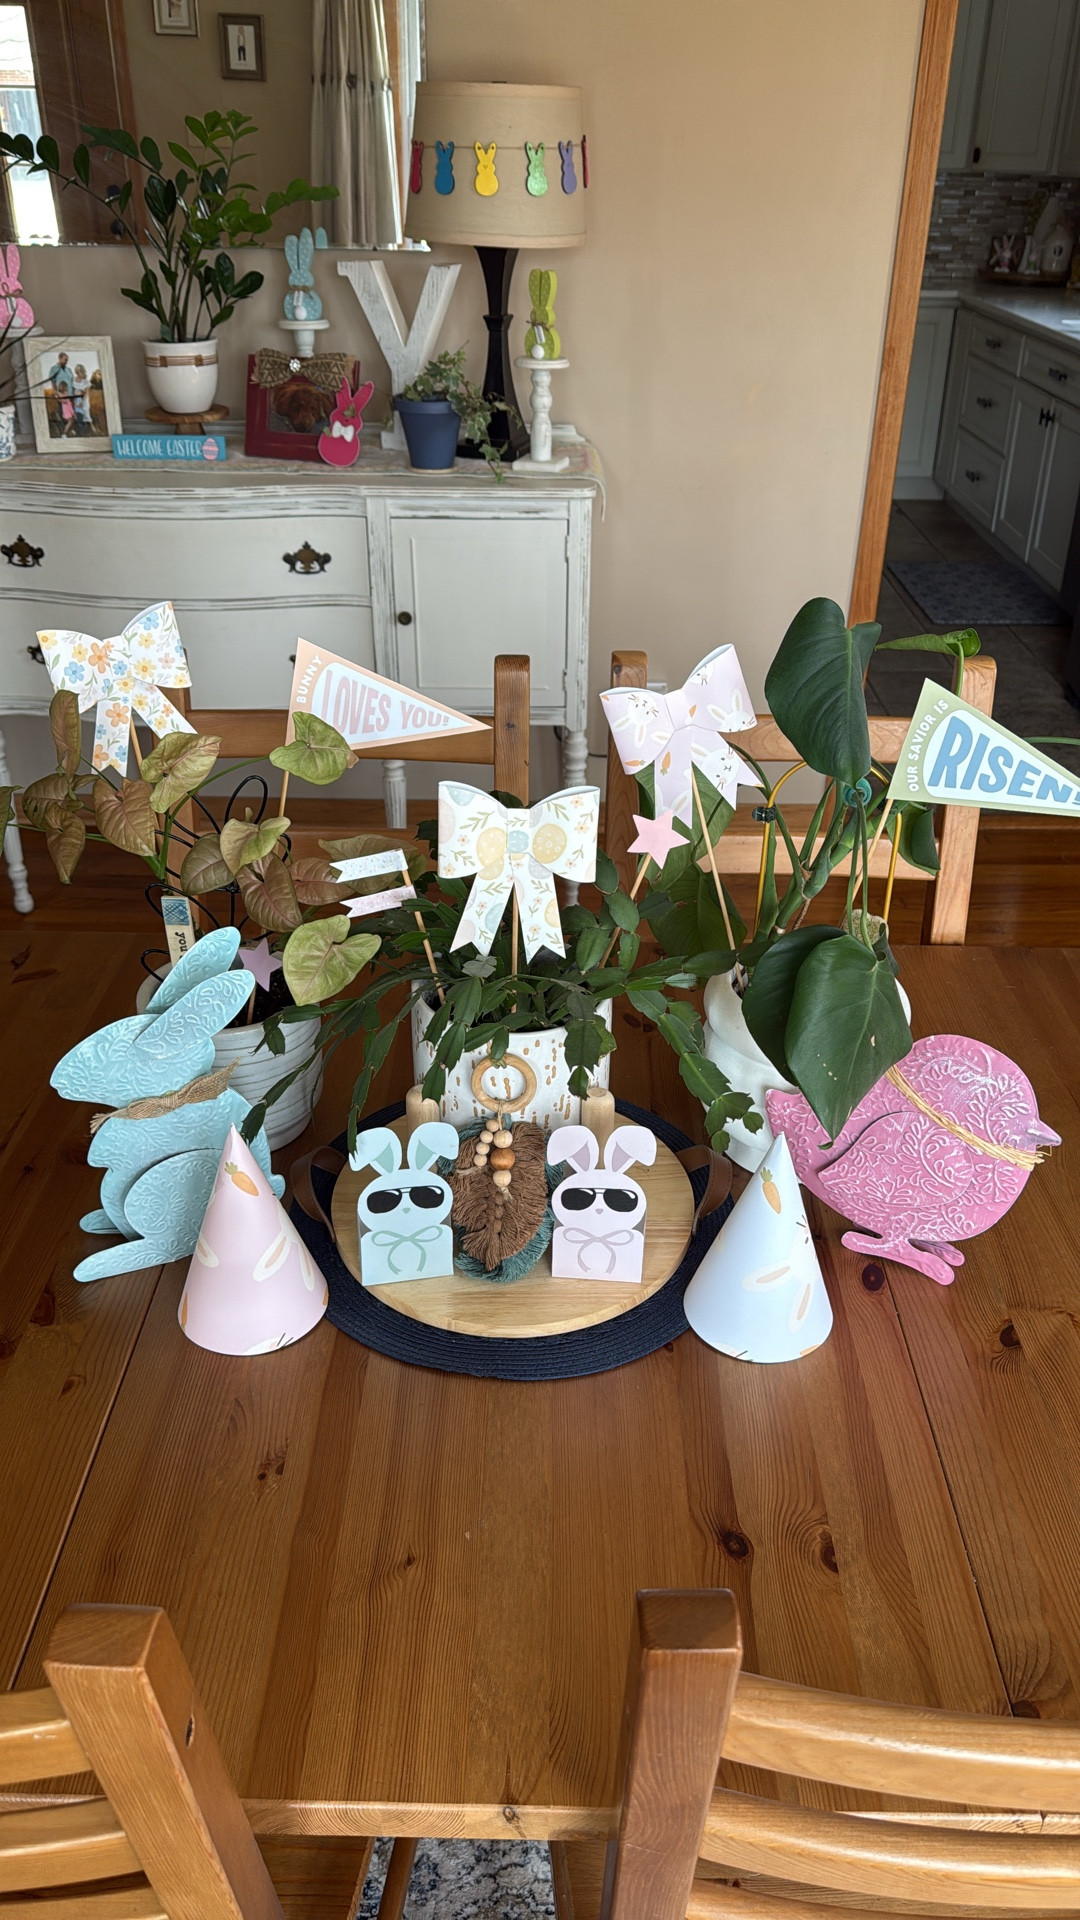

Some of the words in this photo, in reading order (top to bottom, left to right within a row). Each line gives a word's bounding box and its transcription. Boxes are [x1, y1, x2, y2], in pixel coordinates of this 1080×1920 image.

[117, 439, 163, 456] WELCOME
[166, 439, 203, 457] EASTER
[297, 656, 322, 703] BUNNY
[401, 701, 450, 729] YOU!
[933, 699, 949, 715] IS
[908, 715, 936, 761] SAVIOR
[907, 766, 919, 792] OUR
[174, 931, 188, 952] you
